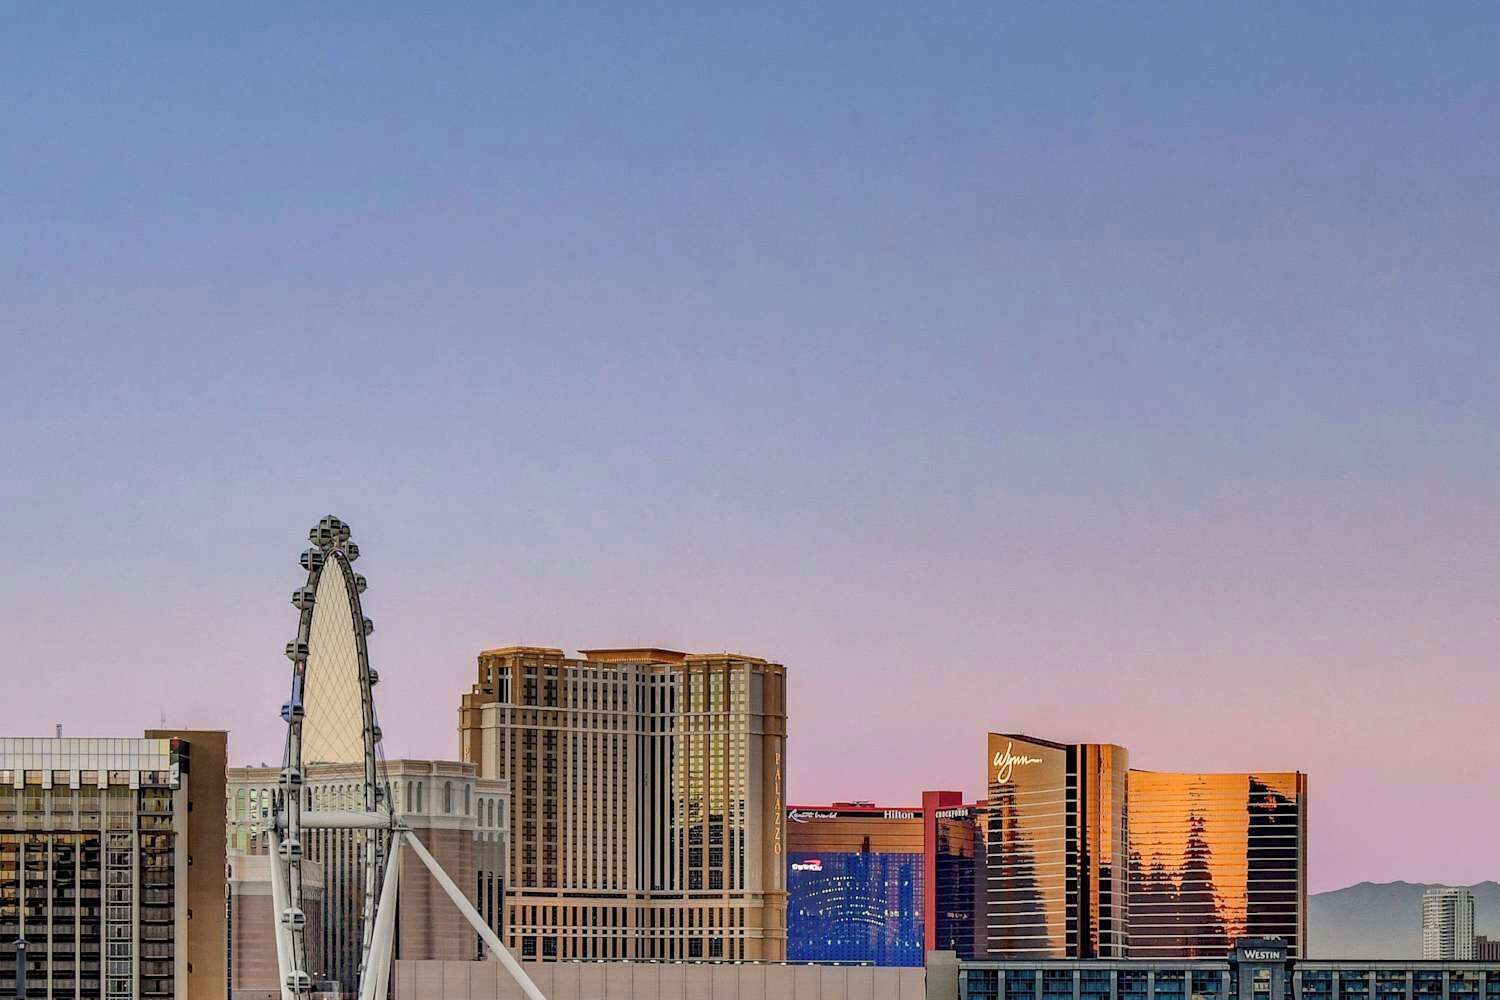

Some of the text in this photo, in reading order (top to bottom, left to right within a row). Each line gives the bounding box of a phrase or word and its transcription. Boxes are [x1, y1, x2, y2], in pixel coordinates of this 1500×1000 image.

[993, 741, 1042, 784] Wynn
[884, 810, 914, 820] Hilton
[1244, 949, 1280, 960] WESTIN
